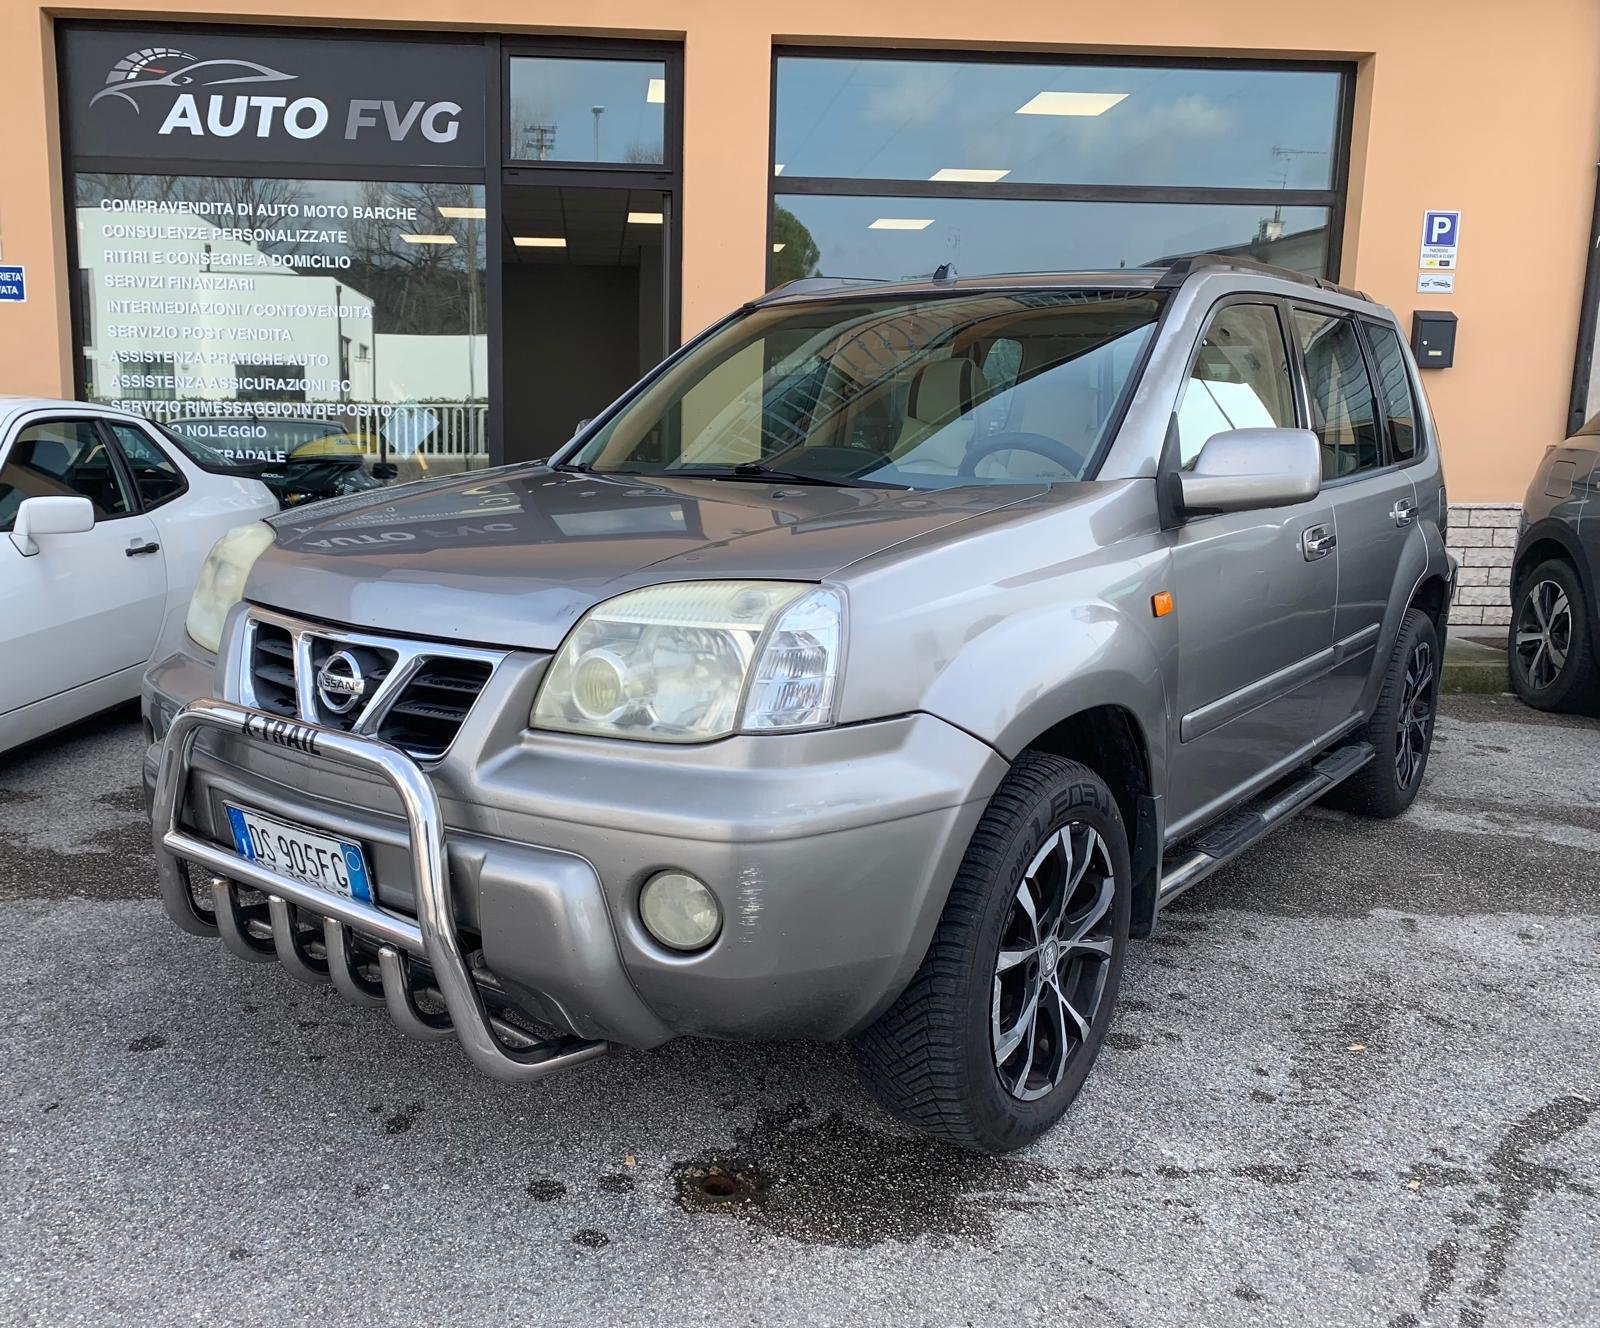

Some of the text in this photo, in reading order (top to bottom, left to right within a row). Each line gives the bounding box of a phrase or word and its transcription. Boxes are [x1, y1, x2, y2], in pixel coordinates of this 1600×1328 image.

[158, 94, 463, 143] AUTO FVG
[100, 198, 418, 221] COMPRAVENDITA DI AUTO MOTO BARCHE
[102, 224, 348, 244] CONSULENZE PERSONALIZZATE
[1431, 216, 1451, 242] P
[104, 250, 352, 270] RITIRI E CONSEGNE A DOMICILIO
[0, 285, 18, 295] ATA
[105, 275, 255, 291] SERVIZI FINANZIARI
[107, 300, 373, 319] INTERMEDIAZIONI / CONTOVENDITA
[108, 325, 292, 342] SERVIZIO POST VENDITA
[110, 351, 329, 367] ASSISTENZA PRATICHE AUTO
[111, 376, 352, 393] ASSISTENZA ASSICURAZIONI RC
[111, 400, 392, 418] SERVIZIO RIMESSAGGIO IN DEPOSITO
[186, 425, 267, 439] NOLEGGIO
[248, 823, 348, 888] DS 905FG
